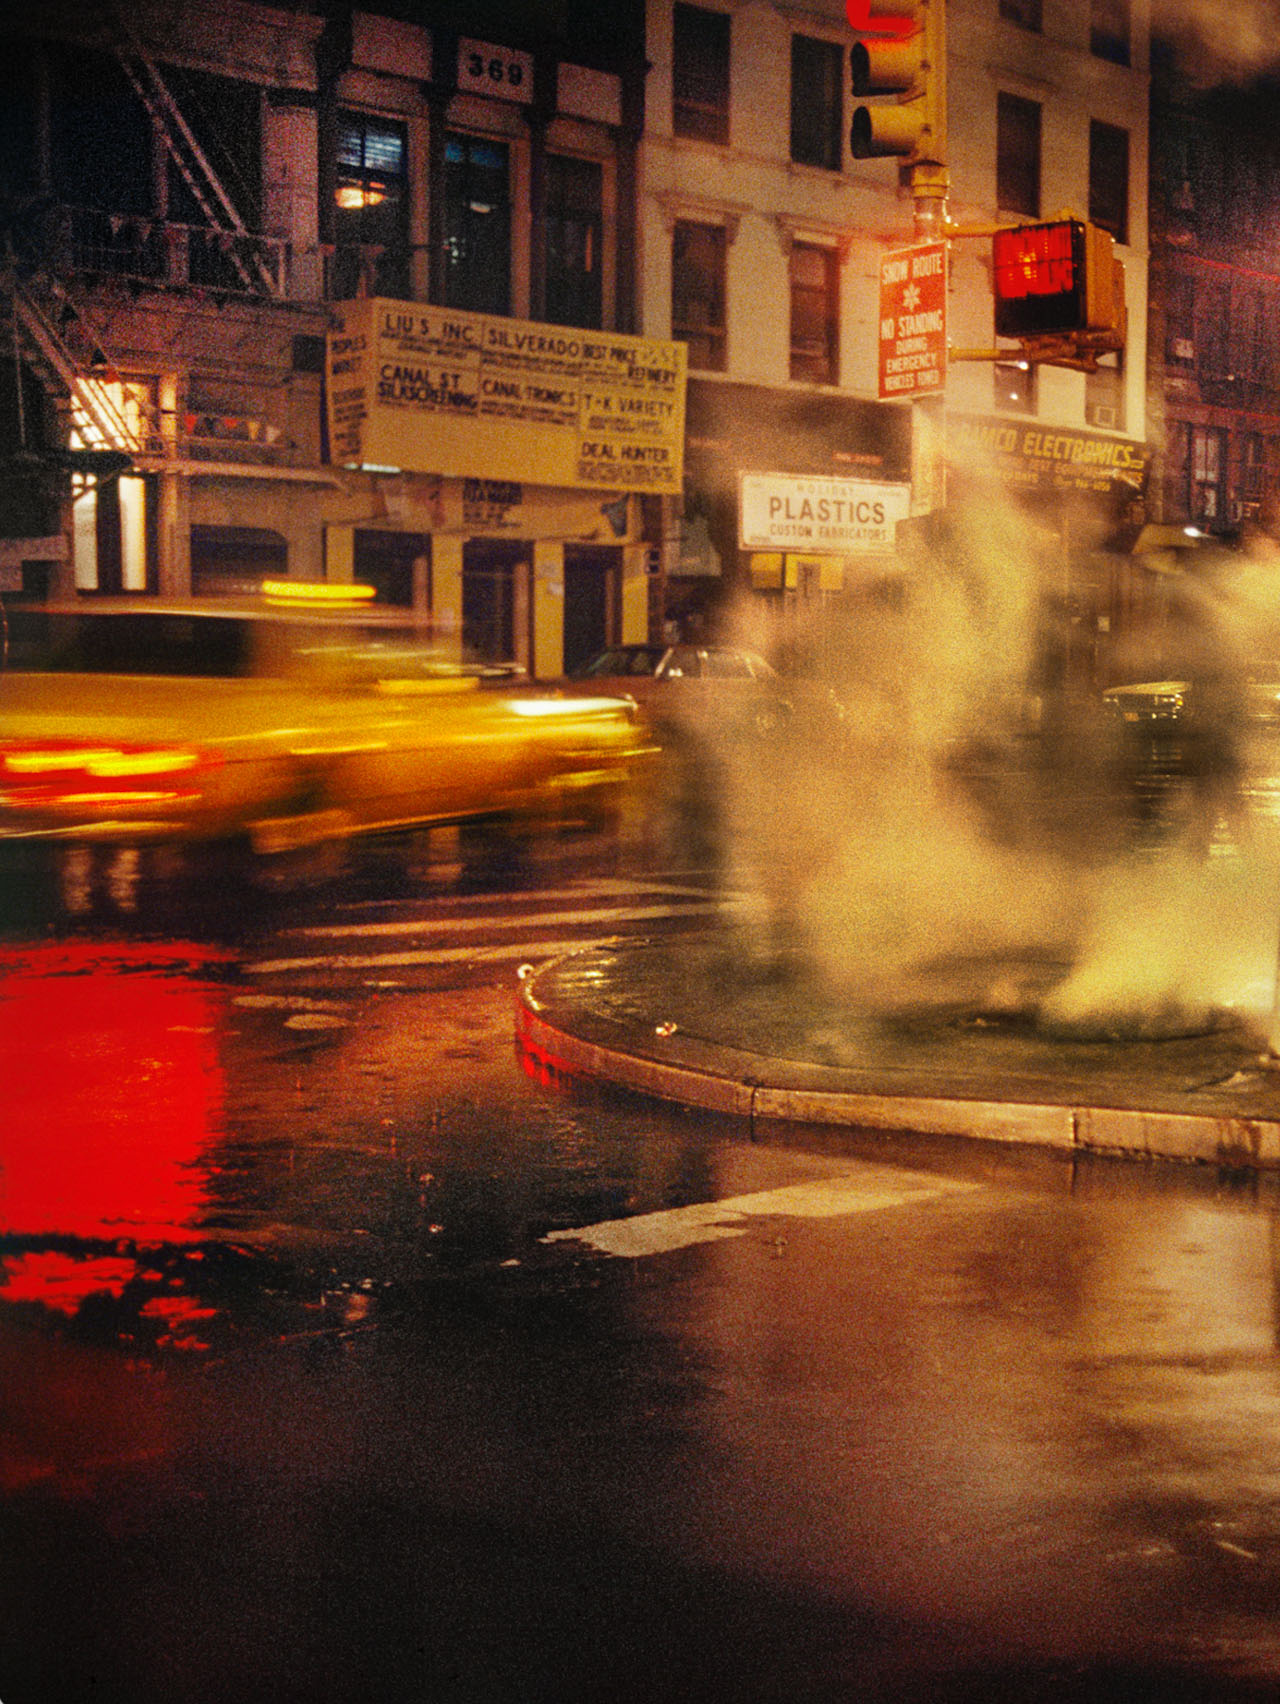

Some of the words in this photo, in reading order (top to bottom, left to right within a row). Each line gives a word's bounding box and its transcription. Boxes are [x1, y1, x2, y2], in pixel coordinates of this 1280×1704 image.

[881, 260, 908, 285] SNOW
[912, 253, 943, 278] ROUTE
[881, 318, 895, 340] NO
[898, 309, 943, 337] STANDING
[488, 327, 580, 359] SILVERADO
[379, 363, 431, 386] CANAL
[440, 371, 462, 390] ST
[618, 396, 674, 417] VARIETY
[581, 441, 616, 460] DEAL
[621, 445, 669, 463] HUNTER
[1023, 431, 1134, 468] ELECTRONICS
[768, 496, 885, 525] PLASTICS
[769, 523, 813, 537] CUSTOM
[818, 526, 886, 541] FABRICATORS
